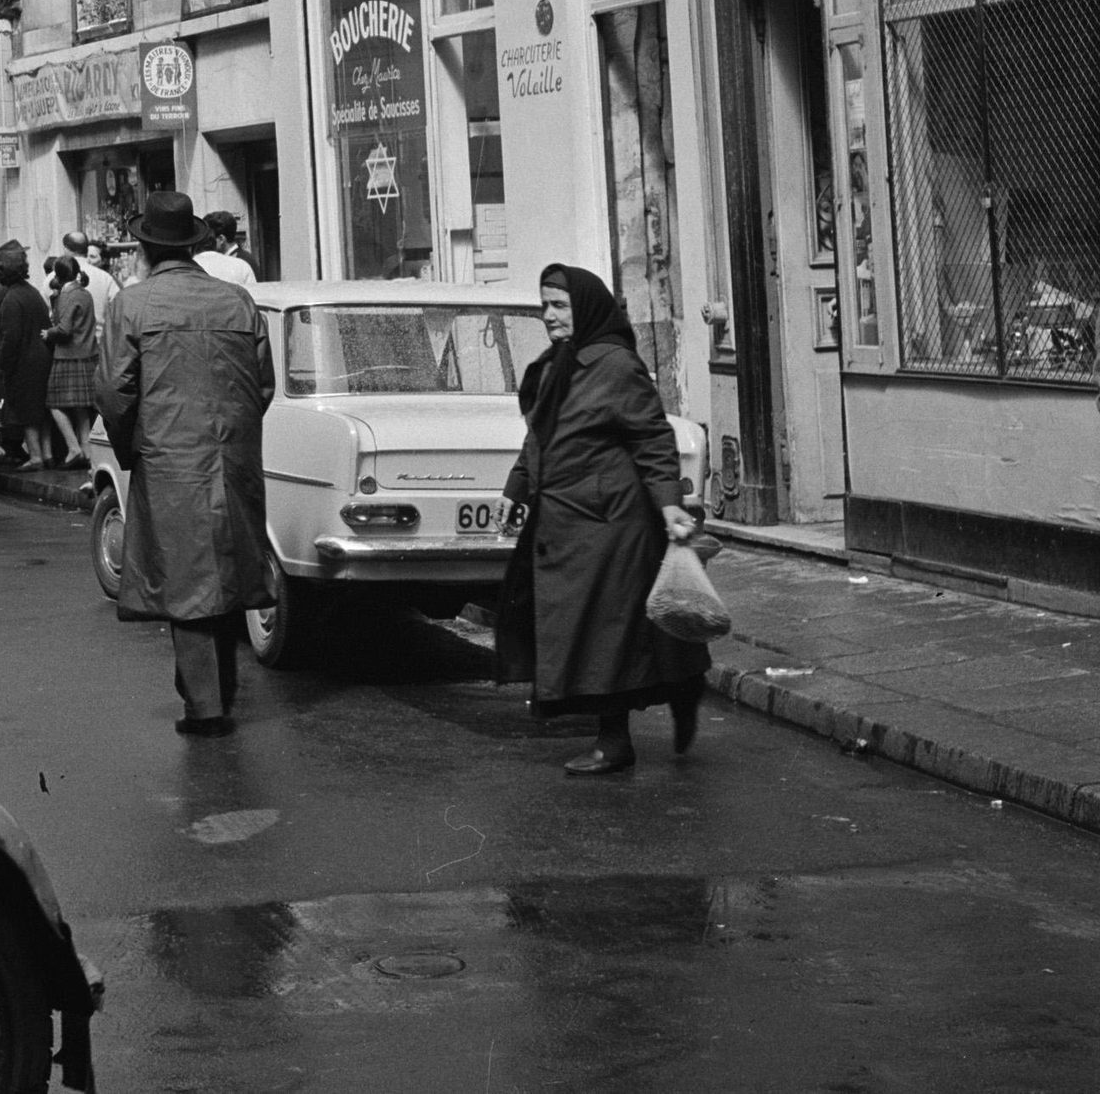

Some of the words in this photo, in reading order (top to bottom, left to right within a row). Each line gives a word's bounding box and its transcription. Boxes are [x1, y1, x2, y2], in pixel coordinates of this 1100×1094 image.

[329, 0, 415, 66] BOUCHERIE
[501, 39, 563, 68] CHARCUTERIE
[160, 83, 188, 97] FRANCE
[507, 65, 563, 99] Volaille
[368, 99, 378, 121] de
[380, 96, 421, 119] Saucisses
